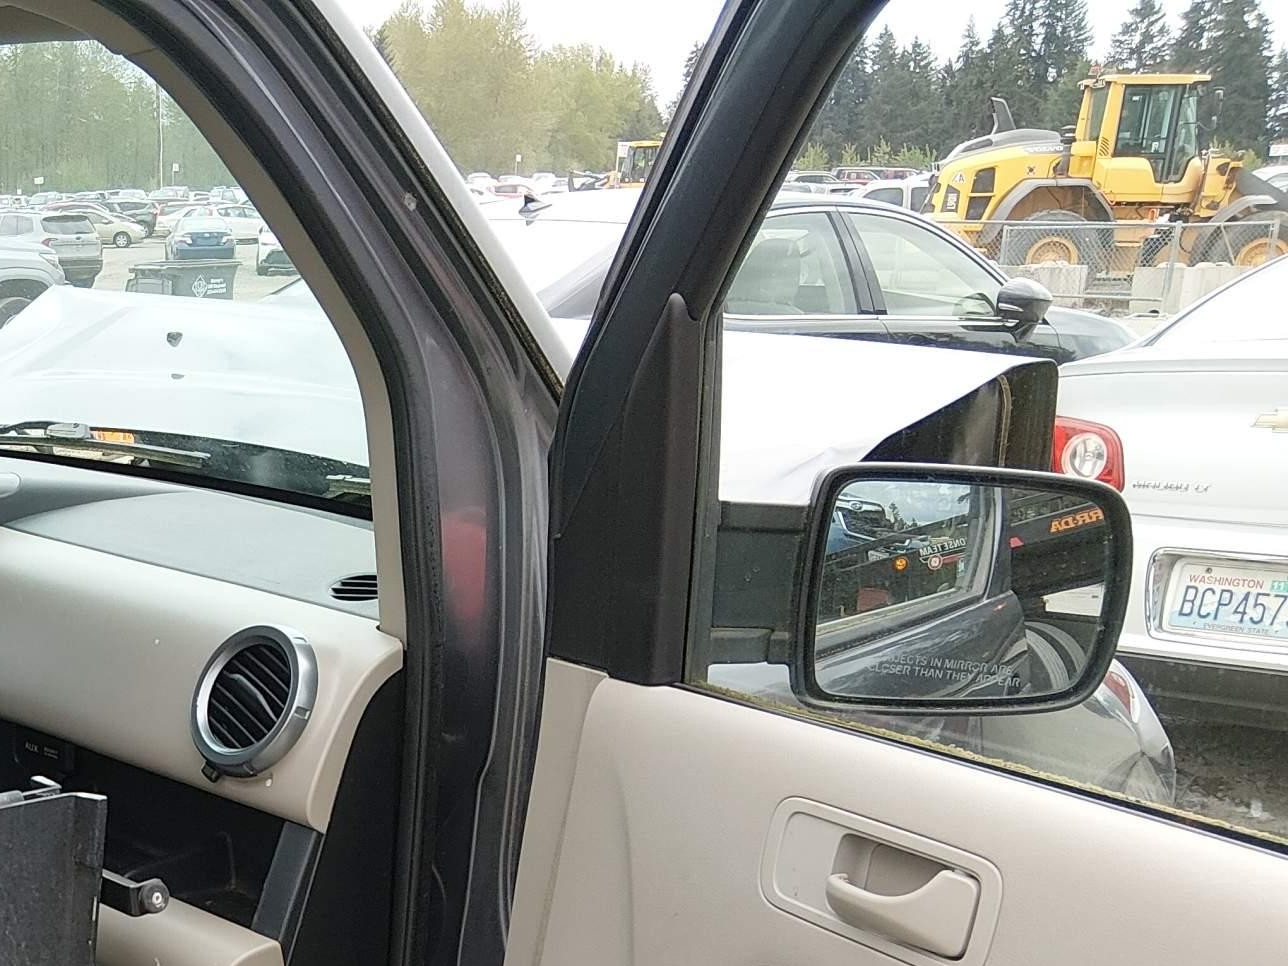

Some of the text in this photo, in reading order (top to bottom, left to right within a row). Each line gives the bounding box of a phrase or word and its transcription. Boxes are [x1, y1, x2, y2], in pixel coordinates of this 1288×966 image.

[1189, 574, 1265, 590] WASHINGTON
[1178, 585, 1288, 627] BCP457
[1202, 622, 1270, 635] EVERGREEN STATE
[868, 662, 911, 676] CLOSER
[913, 666, 944, 680] THAN
[945, 669, 974, 682] THEY
[884, 654, 1013, 675] BJECTS IN MIRROR ARE
[25, 741, 40, 753] AUX
